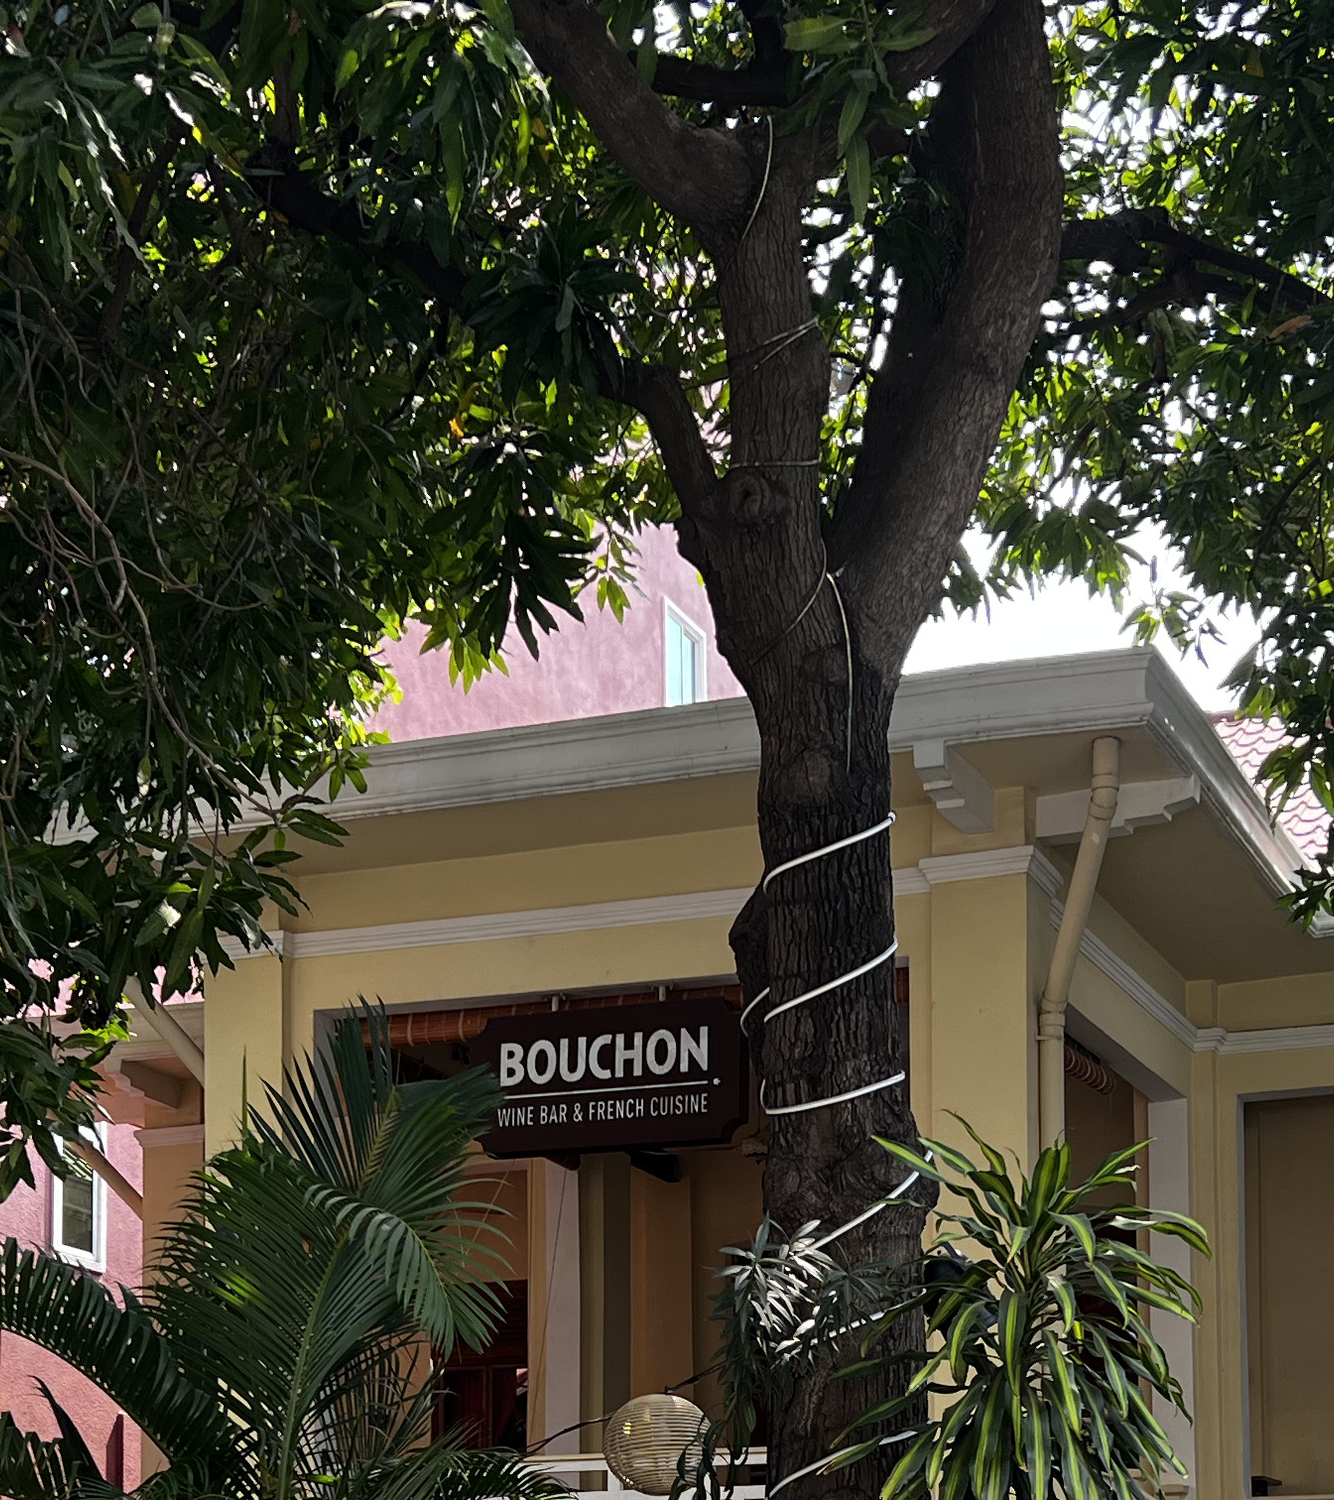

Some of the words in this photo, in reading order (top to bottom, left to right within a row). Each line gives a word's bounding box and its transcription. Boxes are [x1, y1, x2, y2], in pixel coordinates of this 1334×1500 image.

[499, 1025, 709, 1087] BOUCHON
[497, 1105, 534, 1128] WINE
[539, 1103, 568, 1125] BAR
[573, 1102, 584, 1123] &
[588, 1098, 645, 1121] FRENCH
[650, 1093, 709, 1117] CUISINE
